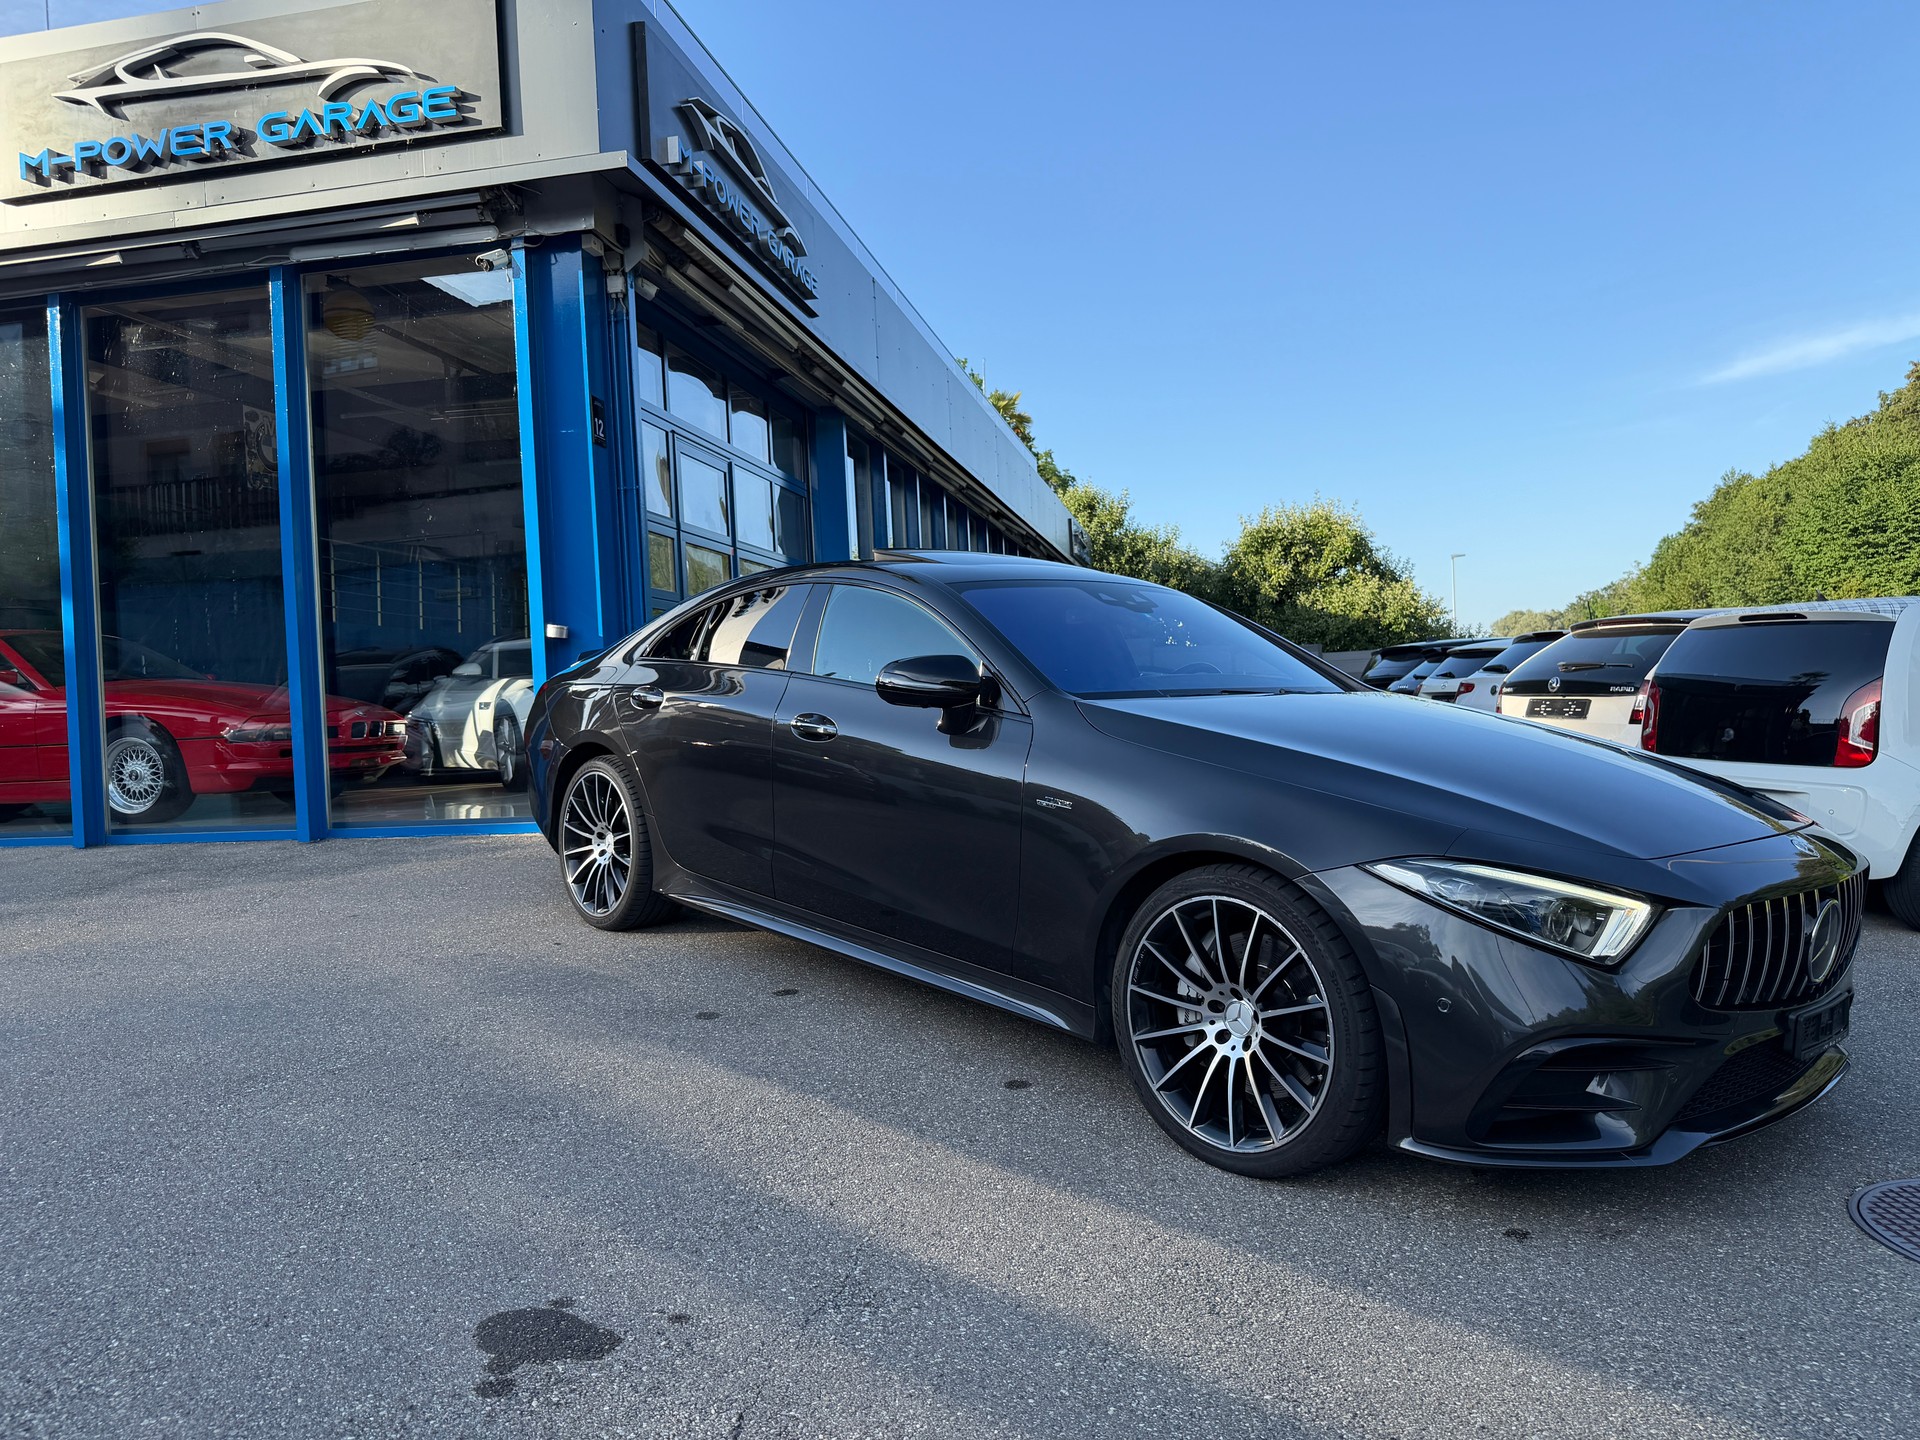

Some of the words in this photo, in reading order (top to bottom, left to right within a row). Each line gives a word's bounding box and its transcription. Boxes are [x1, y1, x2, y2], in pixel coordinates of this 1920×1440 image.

[19, 119, 233, 181] M-POWER
[256, 84, 458, 143] GARAGE
[678, 137, 761, 241] M-POWER
[767, 229, 820, 299] GARAGE
[594, 417, 605, 438] 12
[1609, 685, 1635, 693] RAPID
